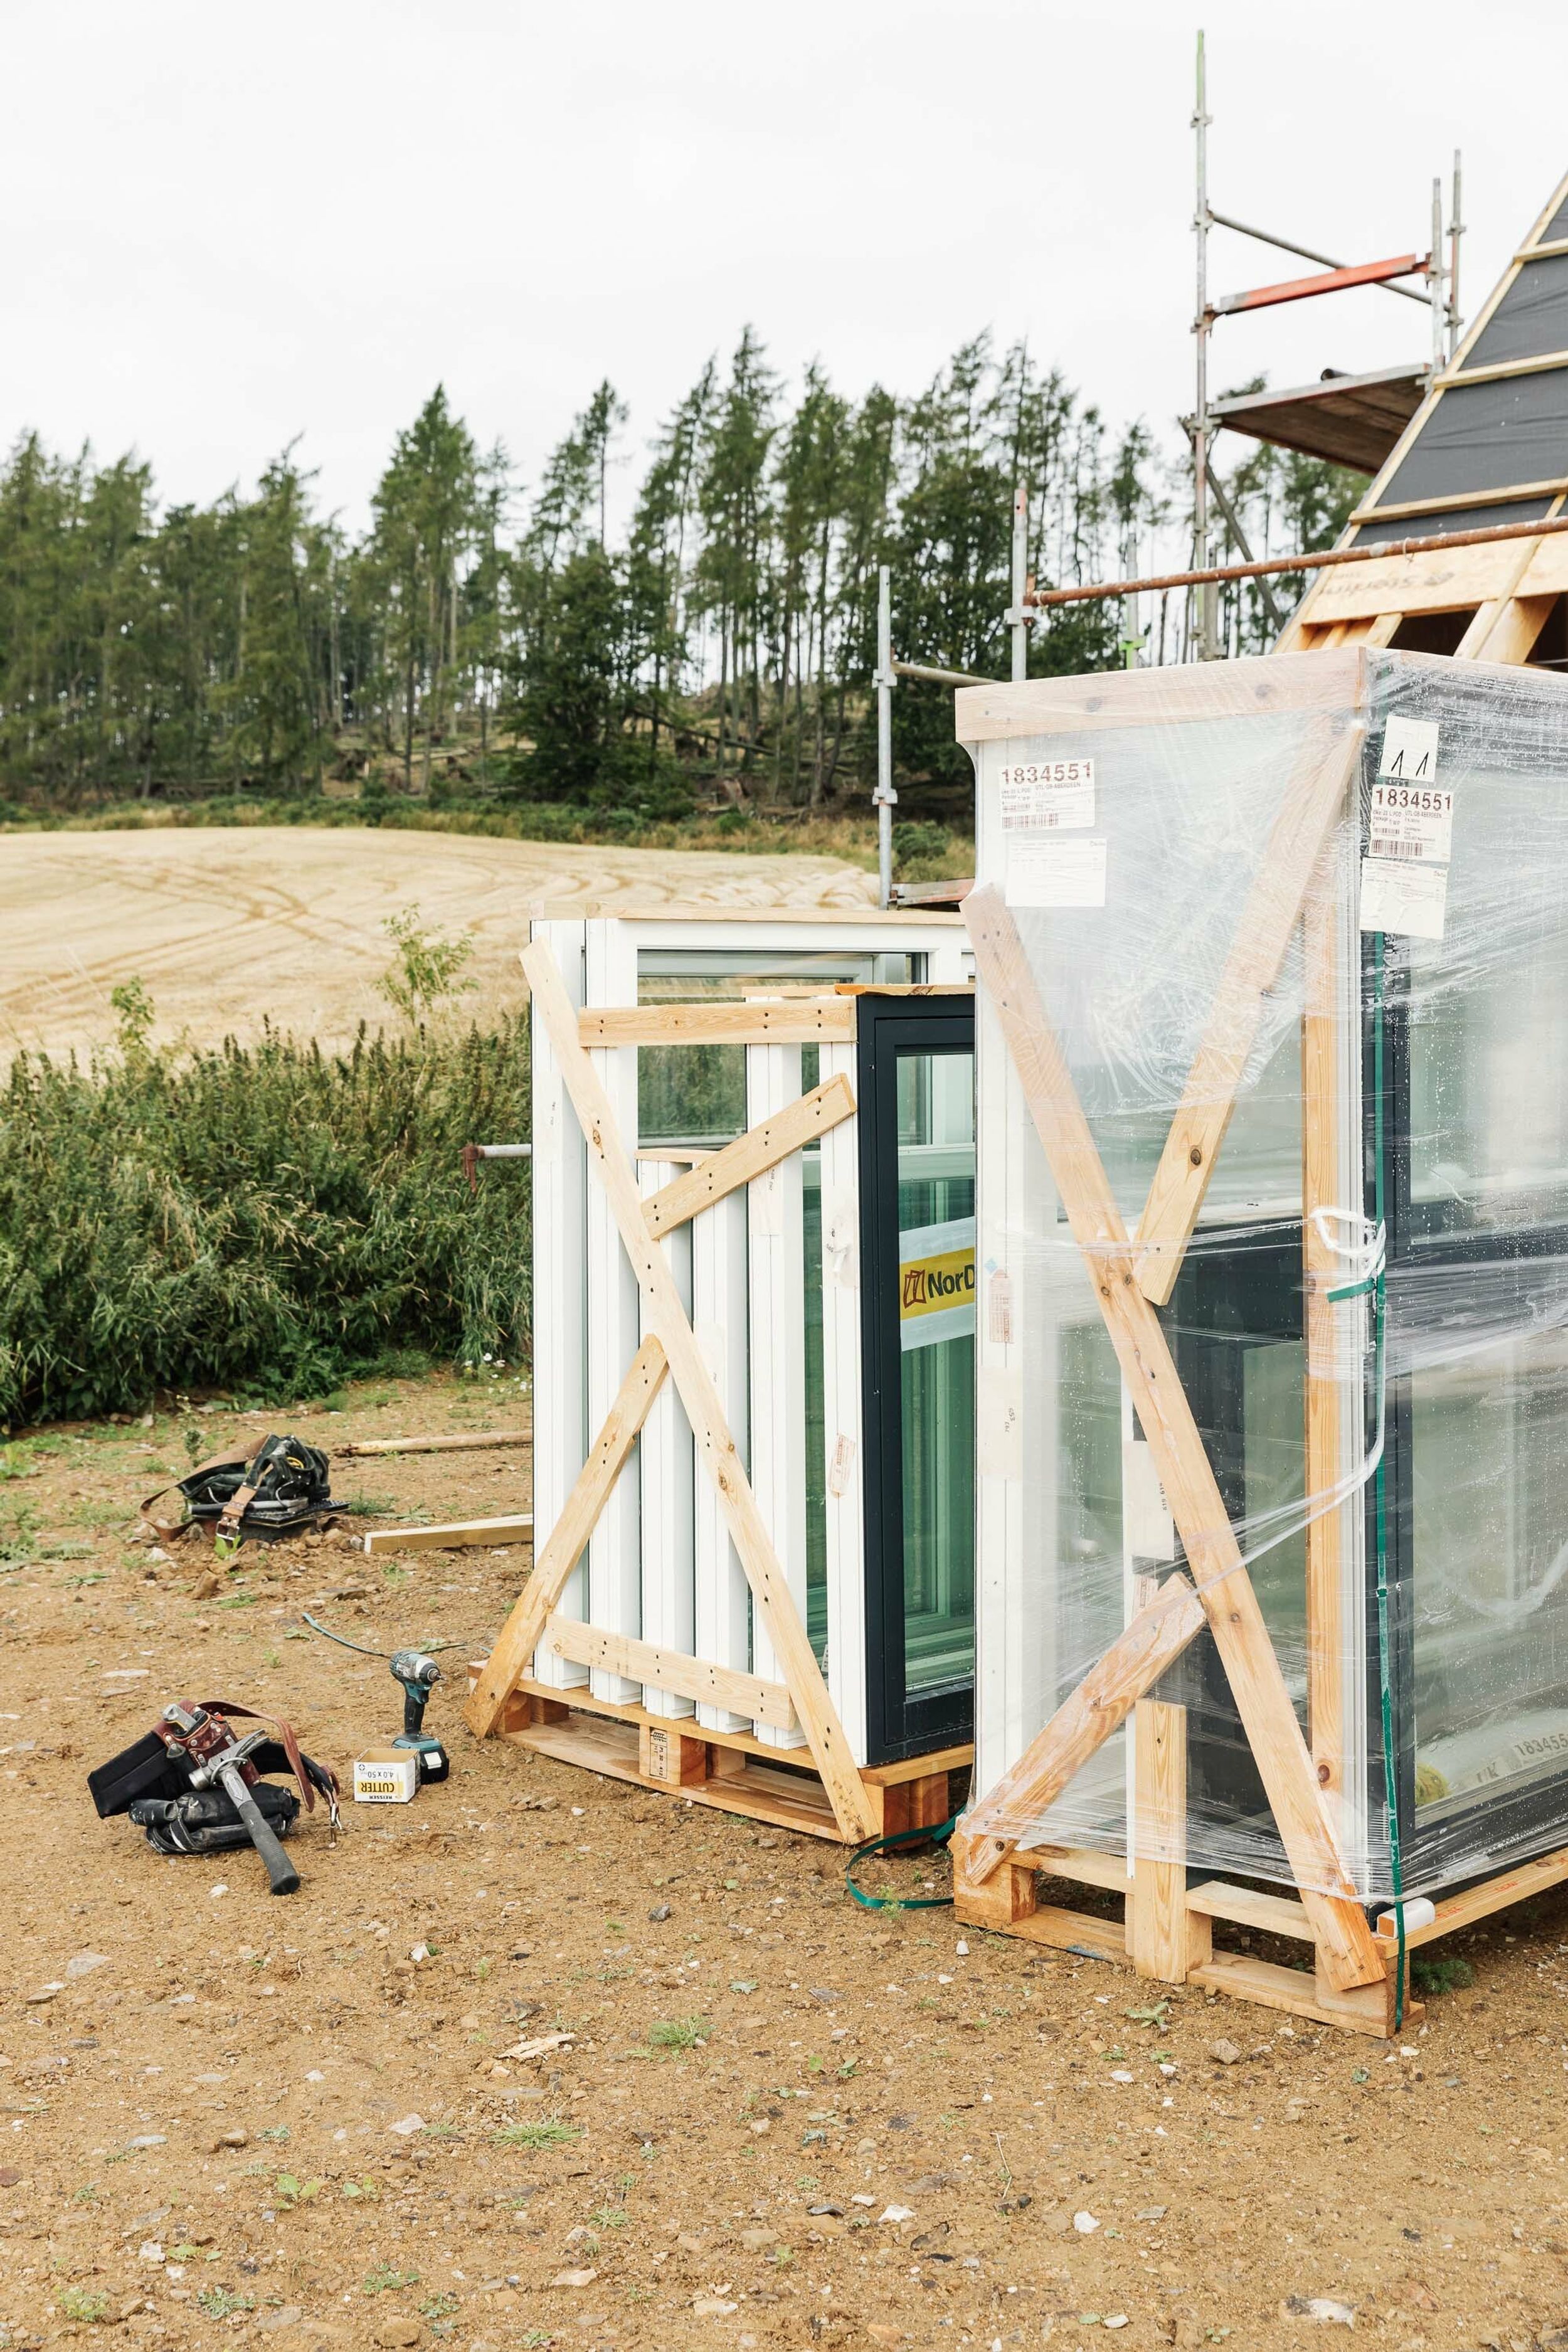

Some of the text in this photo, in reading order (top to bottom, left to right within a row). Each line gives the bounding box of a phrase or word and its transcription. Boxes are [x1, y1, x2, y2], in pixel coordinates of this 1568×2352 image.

[1001, 761, 1091, 785] 1834551
[1375, 787, 1451, 812] 1834551
[361, 1783, 395, 1793] CUTTER
